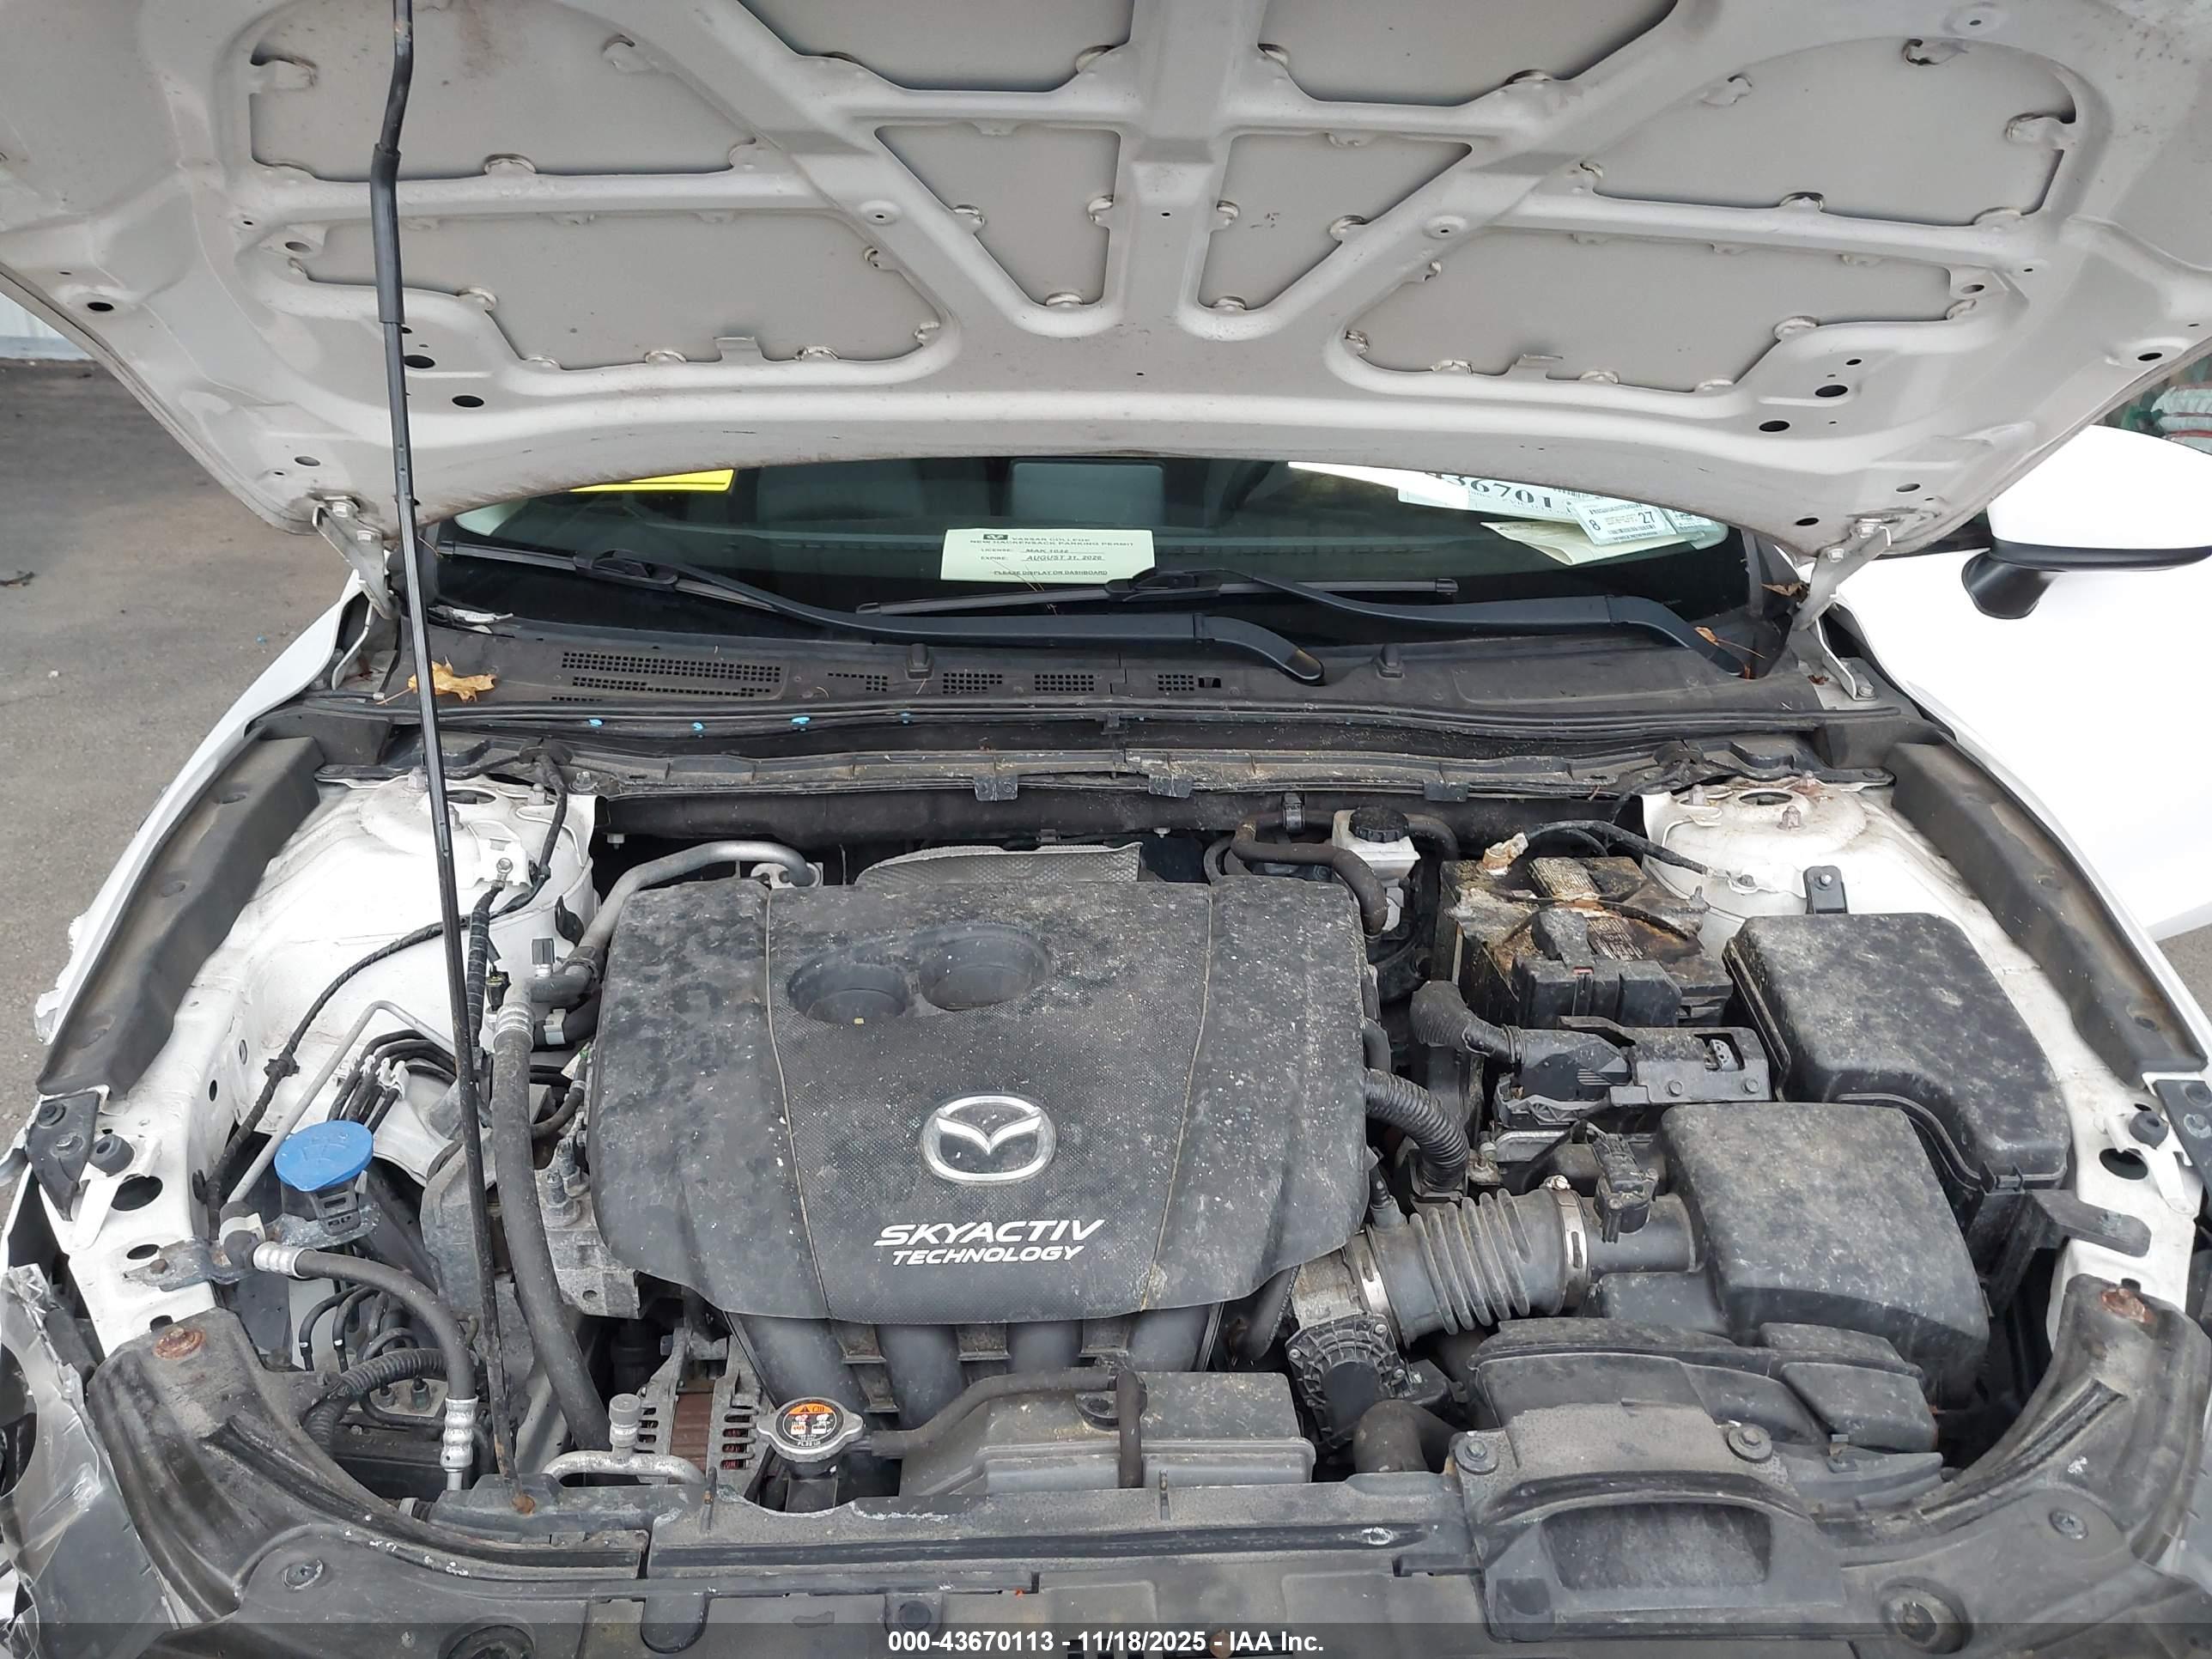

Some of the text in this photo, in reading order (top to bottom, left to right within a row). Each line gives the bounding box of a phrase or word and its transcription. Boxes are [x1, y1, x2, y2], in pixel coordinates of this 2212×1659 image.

[1589, 519, 1601, 531] 8
[1638, 510, 1655, 524] 27
[873, 1219, 1105, 1247] SKYACTIV
[893, 1245, 1085, 1267] TECHNOLOGY
